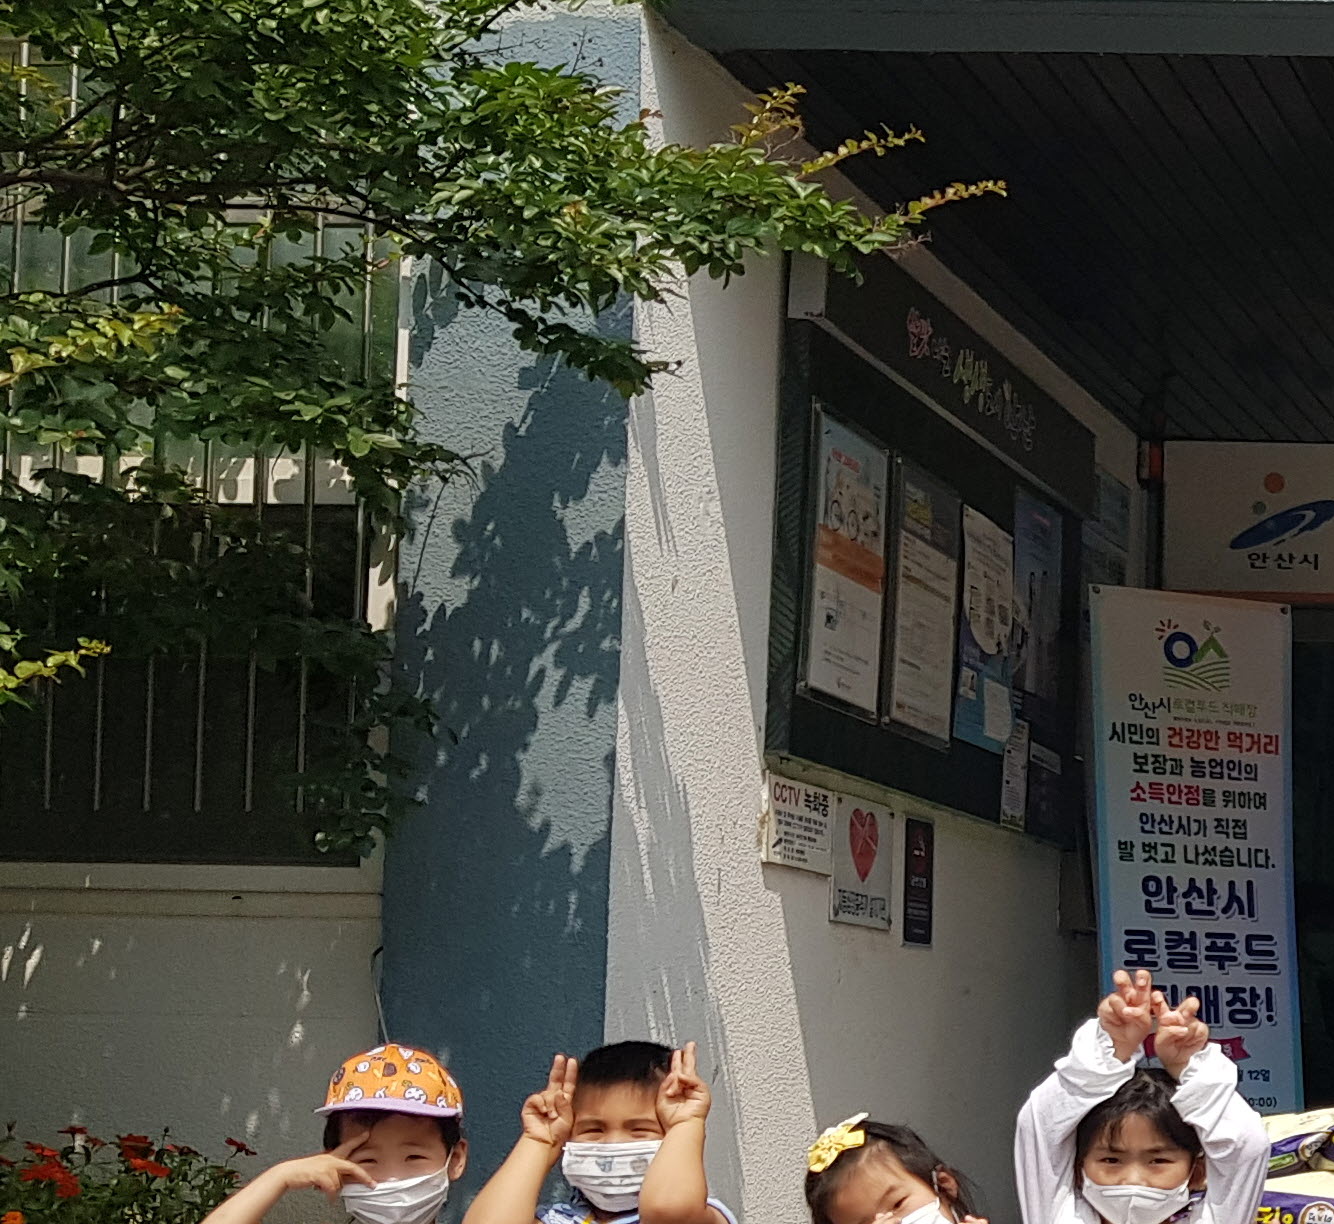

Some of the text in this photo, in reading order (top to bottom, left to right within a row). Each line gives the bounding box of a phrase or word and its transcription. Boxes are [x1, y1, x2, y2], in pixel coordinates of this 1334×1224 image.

[1248, 552, 1319, 571] 안산시
[1128, 692, 1172, 719] 안산시
[1109, 721, 1160, 747] 시민의
[1167, 726, 1220, 750] 건강한
[1227, 731, 1280, 755] 먹거리
[1132, 752, 1259, 782] 보장과 농업인의
[774, 782, 829, 817] CCTV 녹화중
[1130, 781, 1268, 810] 소득안정을 위하여
[1139, 812, 1248, 840] 안산시가 직접
[1117, 840, 1276, 869] 발 벗고 나섰습니다.
[1141, 874, 1257, 920] 안산시
[1123, 929, 1280, 974] 로컬푸드
[1247, 1069, 1271, 1081] 12일
